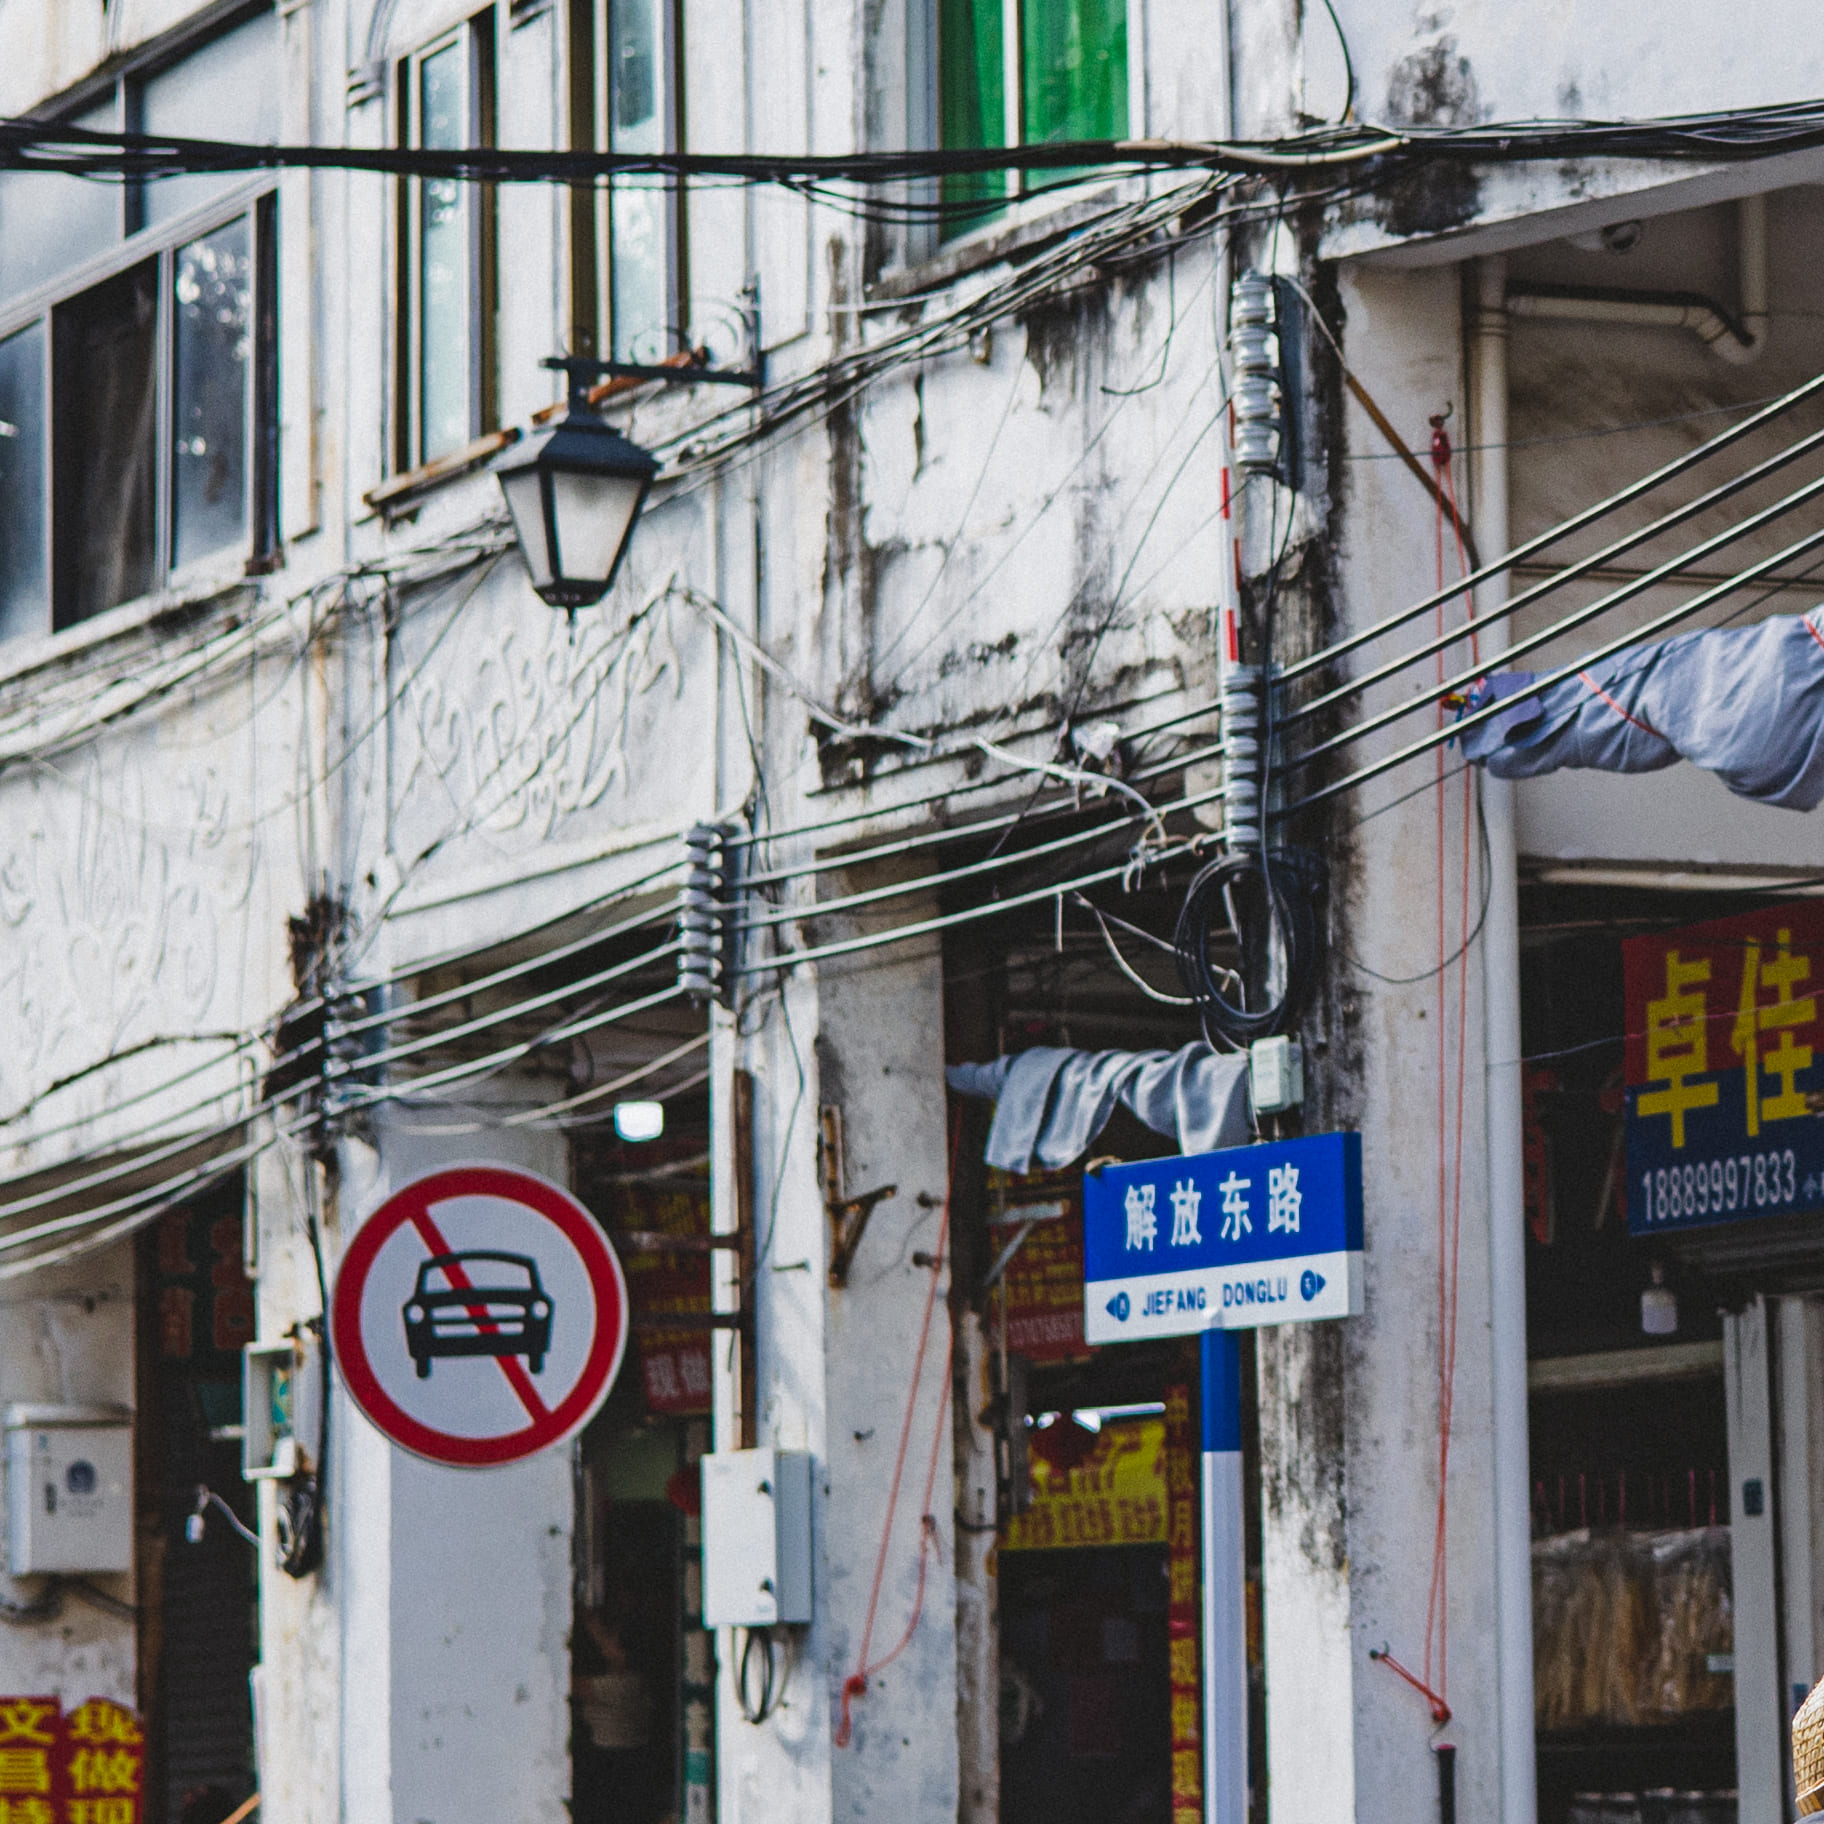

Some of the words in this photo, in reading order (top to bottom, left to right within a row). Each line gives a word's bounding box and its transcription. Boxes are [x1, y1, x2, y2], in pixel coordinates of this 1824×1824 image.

[1637, 928, 1817, 1148] 卓佳
[1124, 1162, 1302, 1252] 解放东路
[1141, 1286, 1207, 1317] JIEFANG
[1222, 1277, 1288, 1308] DONGLU
